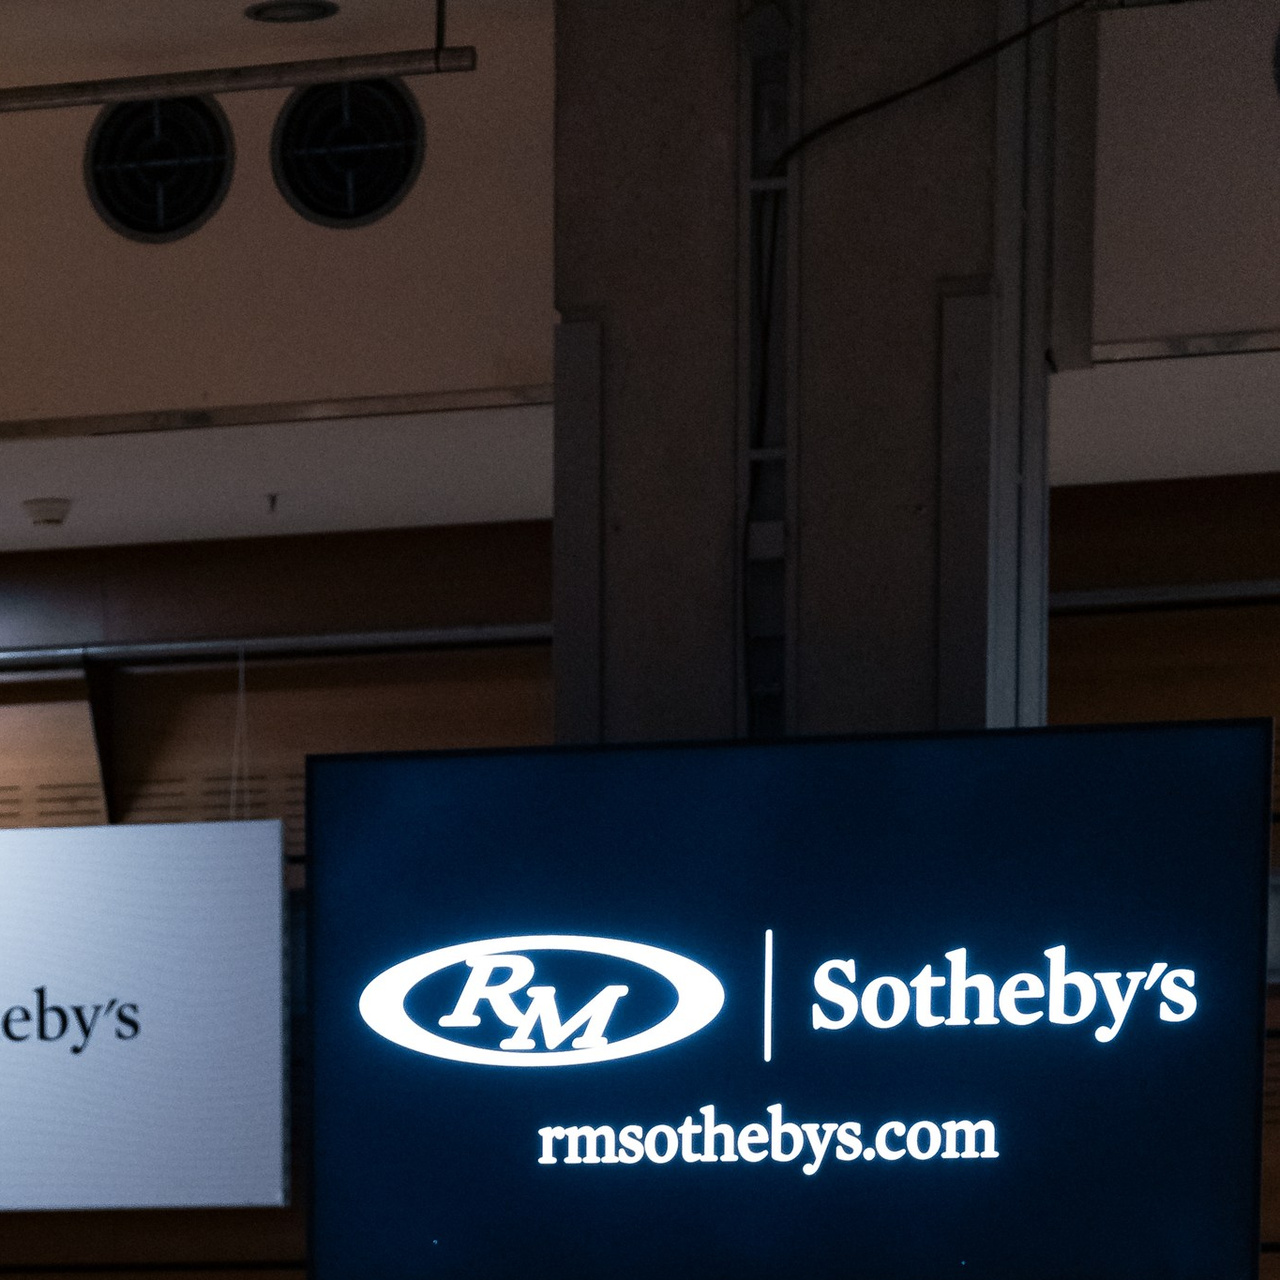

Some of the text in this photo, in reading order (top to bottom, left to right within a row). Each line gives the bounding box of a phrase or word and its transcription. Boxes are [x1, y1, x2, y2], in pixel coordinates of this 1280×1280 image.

[439, 944, 1198, 1051] RM Sotheby's
[537, 1103, 1000, 1176] rmsothebys.com
